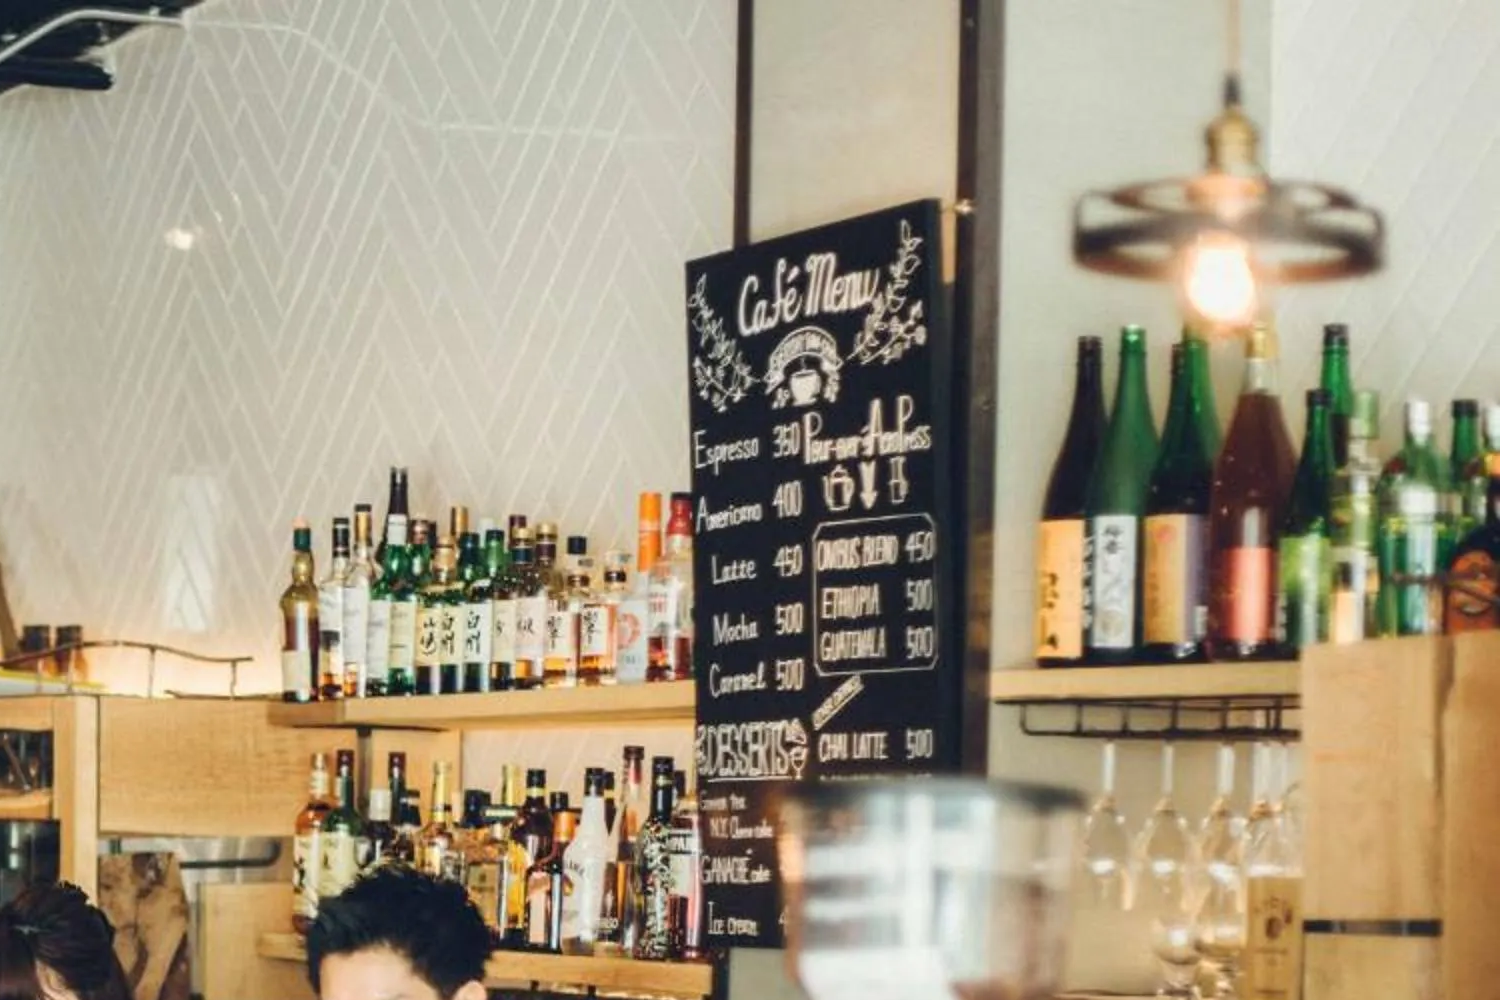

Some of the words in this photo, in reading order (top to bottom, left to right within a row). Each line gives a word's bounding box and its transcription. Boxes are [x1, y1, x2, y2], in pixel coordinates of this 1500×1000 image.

[738, 257, 801, 336] Café
[805, 252, 879, 316] Menu
[694, 429, 759, 476] Espresso
[772, 422, 800, 459] 350
[696, 495, 762, 534] Americano
[772, 480, 803, 519] 400
[711, 554, 758, 585] Latte
[772, 544, 803, 577] 450
[905, 531, 935, 563] 450
[821, 582, 880, 620] ETHIOPIA
[906, 577, 933, 612] 500
[712, 612, 758, 647] Mocha
[775, 602, 804, 636] 500
[820, 625, 886, 662] GUATEMALA
[906, 624, 934, 660] 500
[775, 657, 804, 692] 500
[707, 719, 789, 776] DESSERTS
[819, 732, 848, 763] CHAI
[852, 731, 889, 761] LATTE
[906, 728, 933, 760] 500
[707, 901, 725, 935] Ice
